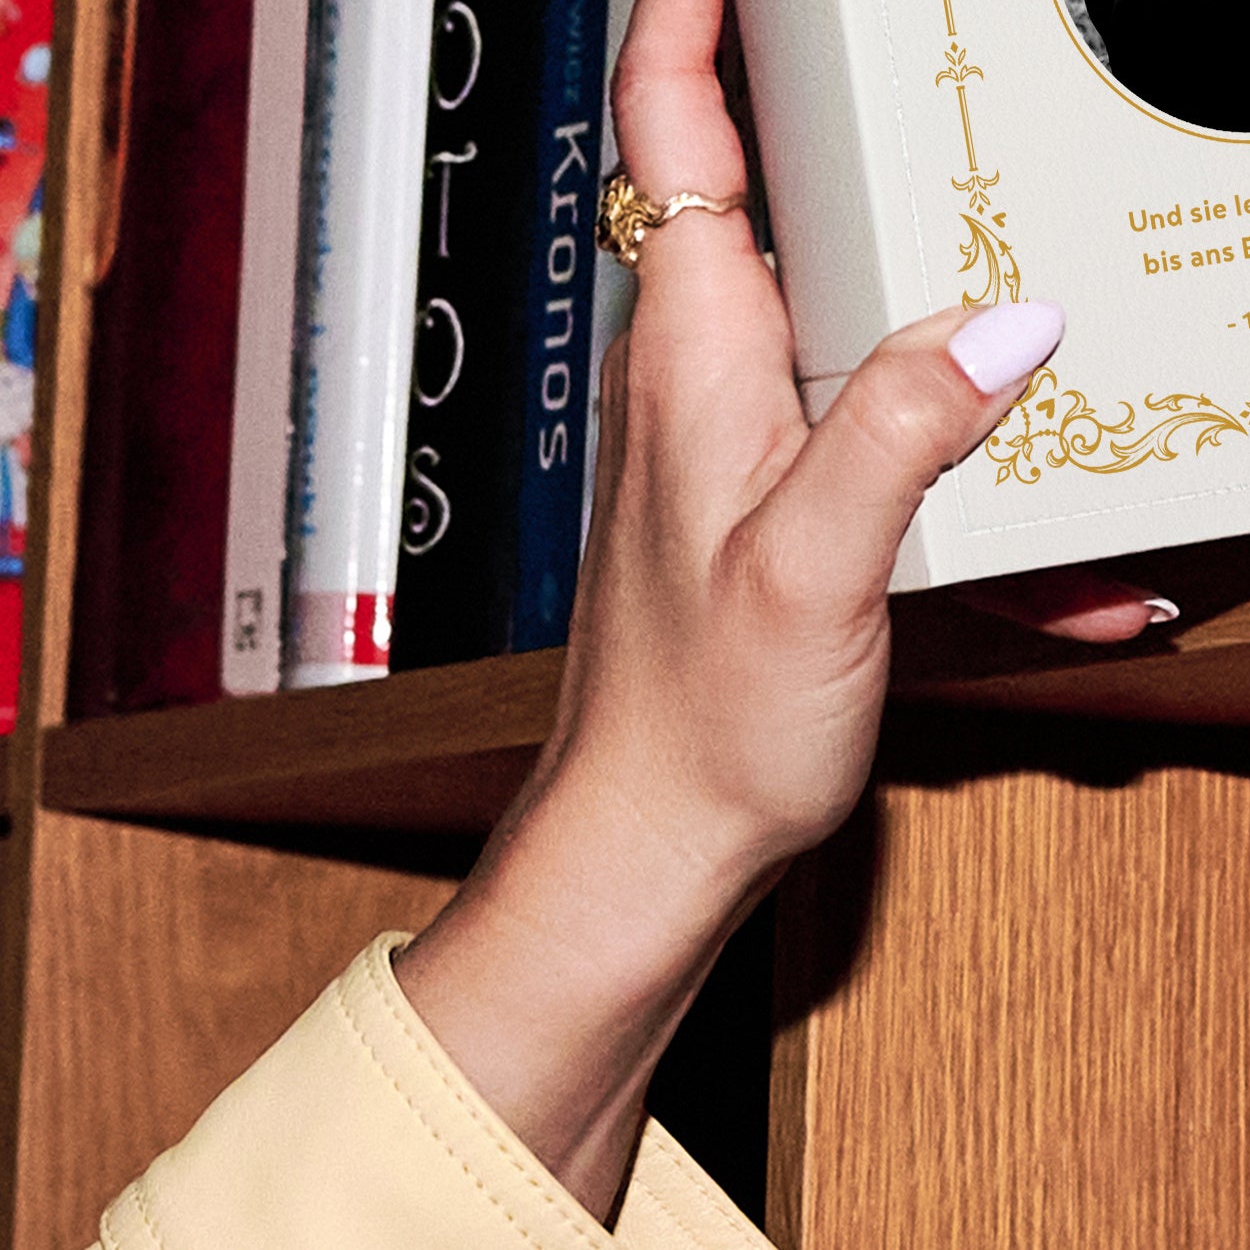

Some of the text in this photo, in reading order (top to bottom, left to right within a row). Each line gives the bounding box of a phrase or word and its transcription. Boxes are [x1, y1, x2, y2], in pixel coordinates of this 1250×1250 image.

[1127, 203, 1183, 233] Und
[1189, 199, 1227, 223] sie
[1142, 250, 1183, 275] bis
[1190, 245, 1235, 268] ans
[538, 120, 590, 471] Kronos
